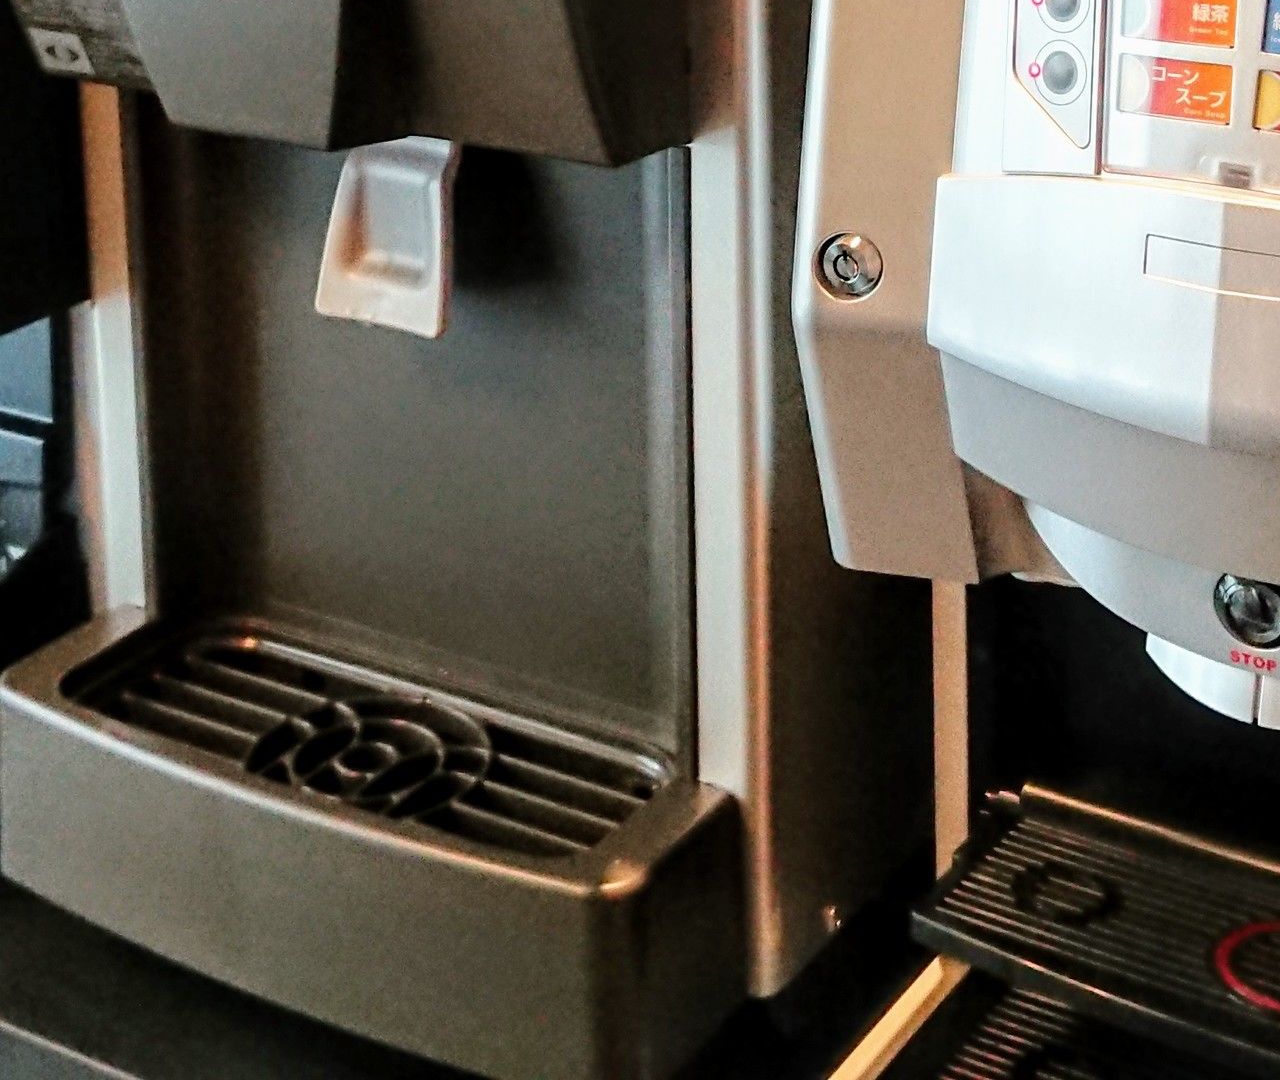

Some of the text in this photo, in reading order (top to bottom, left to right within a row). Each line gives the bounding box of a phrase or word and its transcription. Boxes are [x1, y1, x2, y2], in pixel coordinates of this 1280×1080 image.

[1191, 3, 1230, 24] 緑茶
[1151, 65, 1200, 86] コーン
[1175, 87, 1227, 108] スープ
[1229, 648, 1279, 673] STOP
